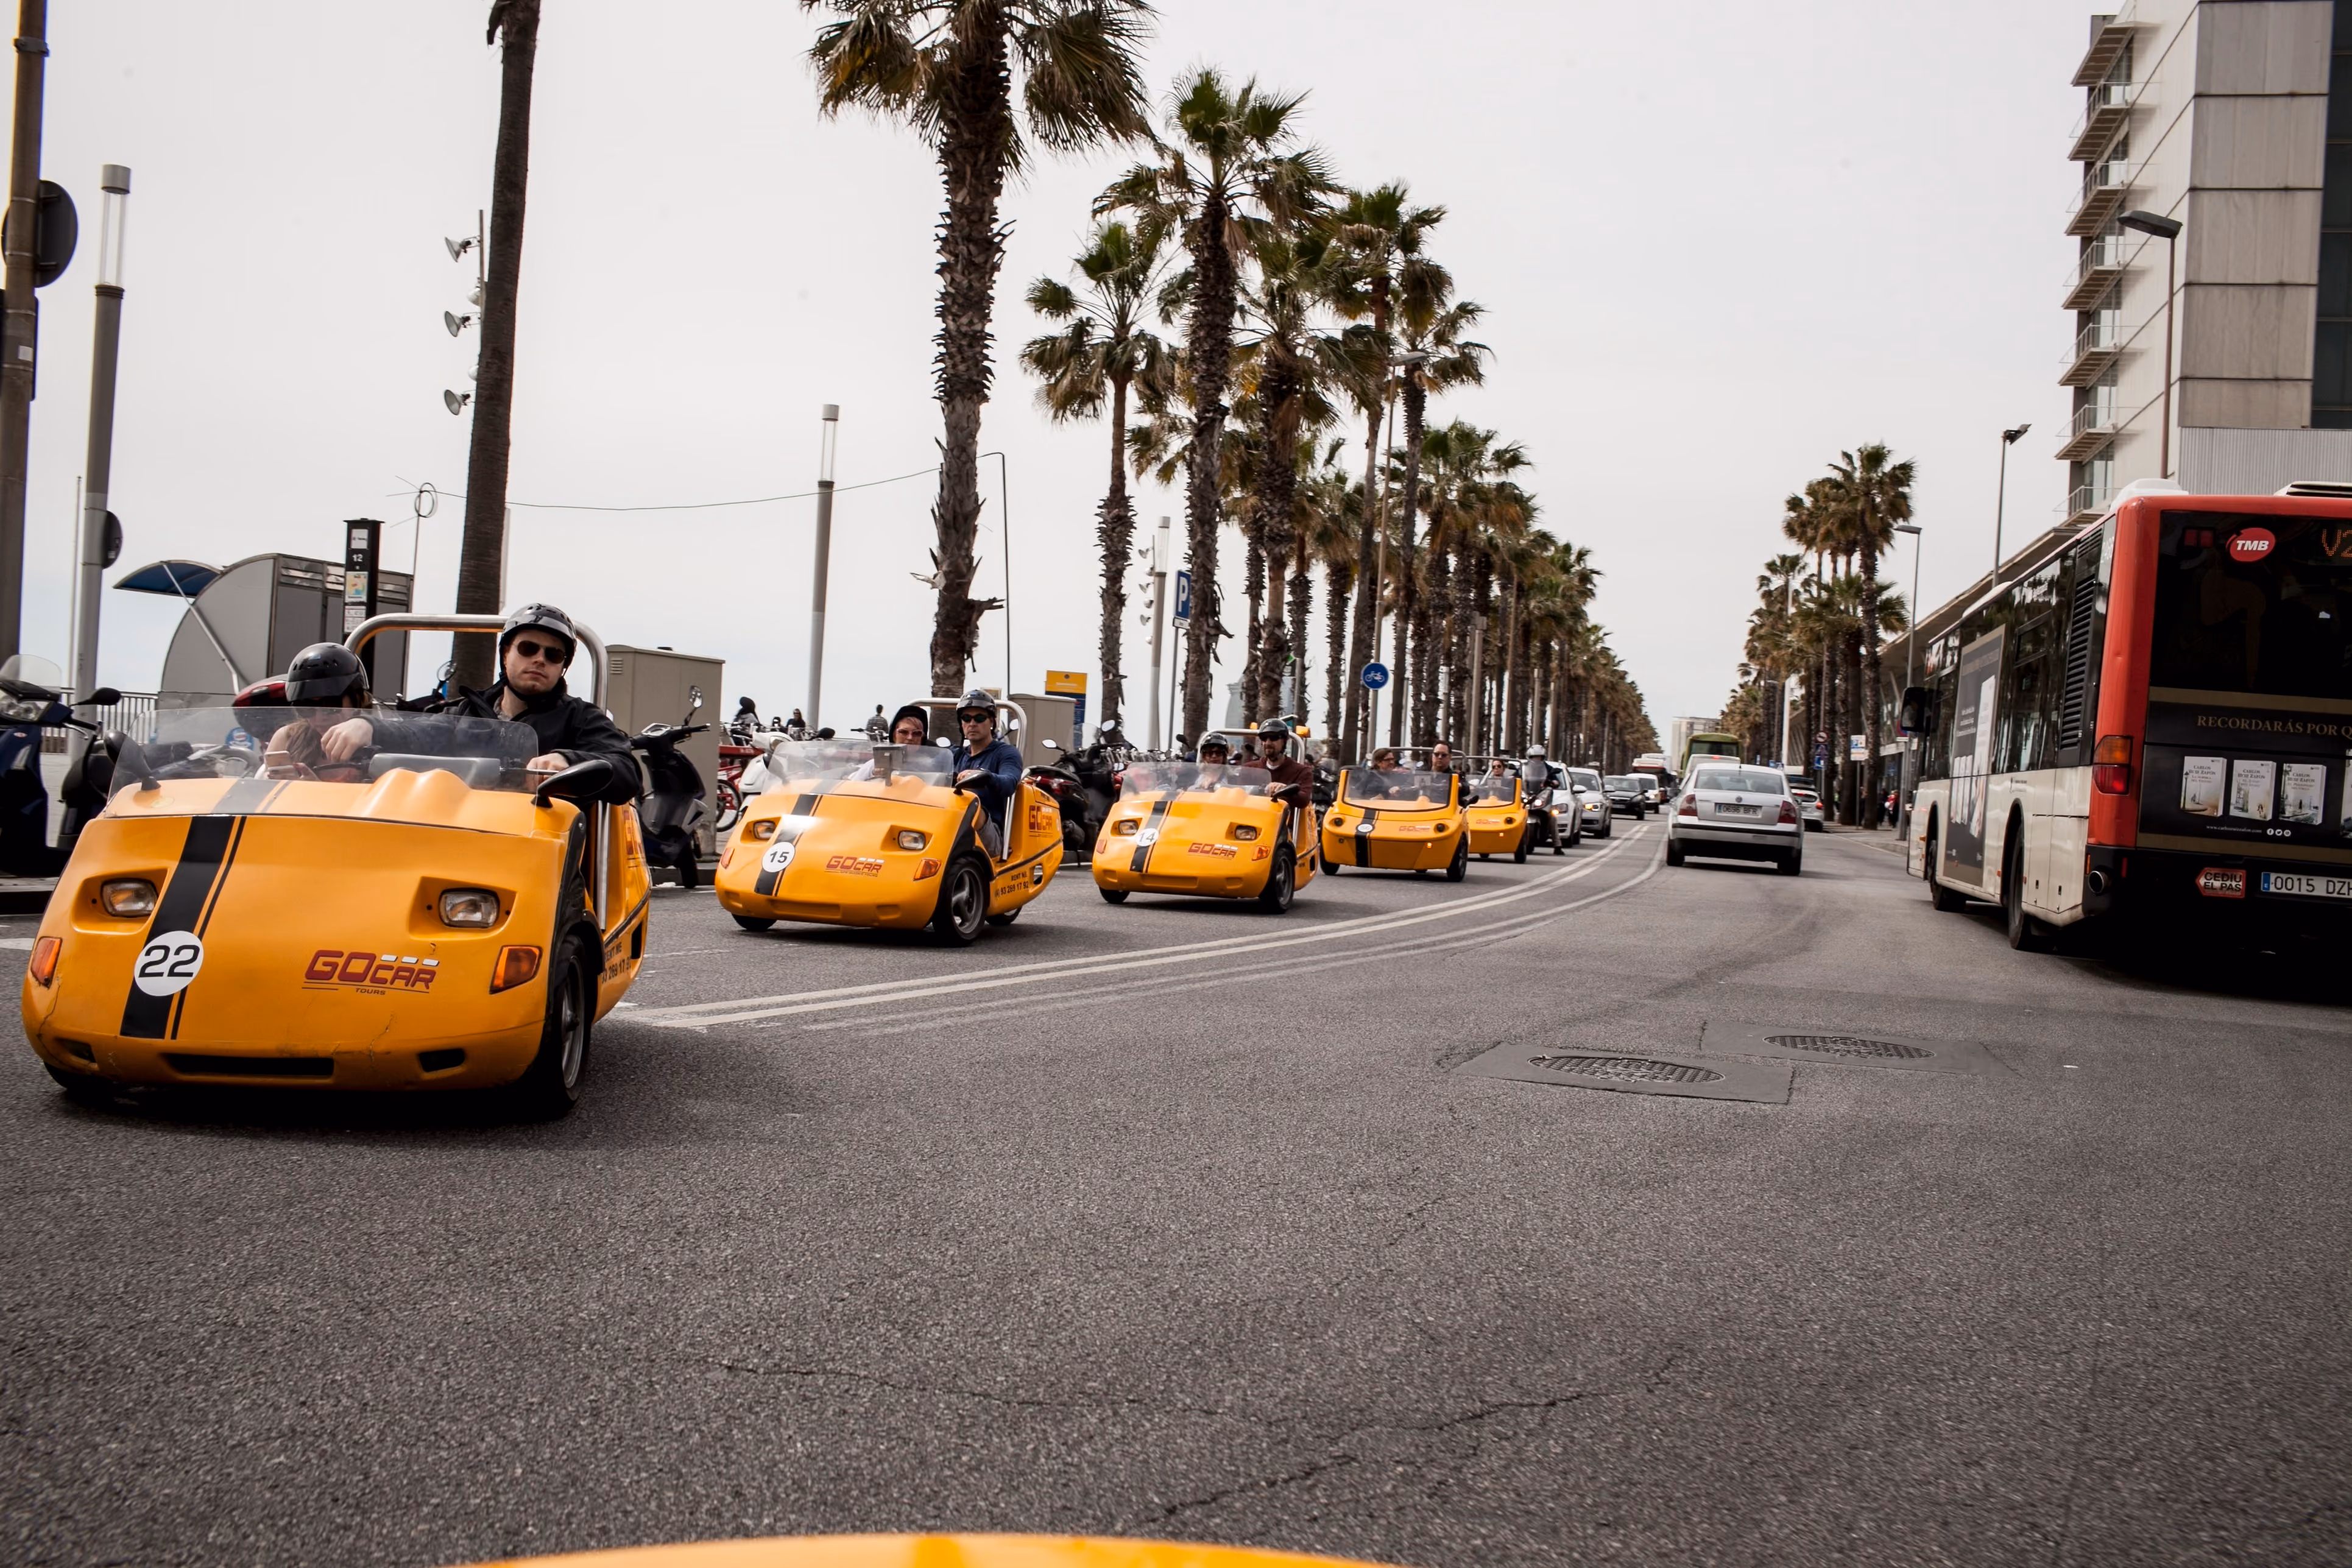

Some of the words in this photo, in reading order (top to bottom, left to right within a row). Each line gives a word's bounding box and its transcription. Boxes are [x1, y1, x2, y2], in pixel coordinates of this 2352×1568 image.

[2236, 540, 2270, 551] TMB
[352, 554, 363, 562] 12
[1178, 576, 1188, 612] P
[2196, 715, 2303, 733] RECORDARÁS
[2306, 722, 2338, 736] POR
[1139, 832, 1156, 842] 14
[770, 851, 789, 863] 15
[1188, 842, 1237, 858] GOCAR
[826, 856, 883, 873] GOCAR
[2203, 871, 2243, 883] CEDIU
[1017, 881, 1022, 891] 17
[2203, 881, 2216, 890] EL
[2220, 883, 2242, 892] PAS
[2273, 876, 2315, 893] 0015
[138, 944, 200, 978] 22
[305, 949, 437, 990] GOCAR
